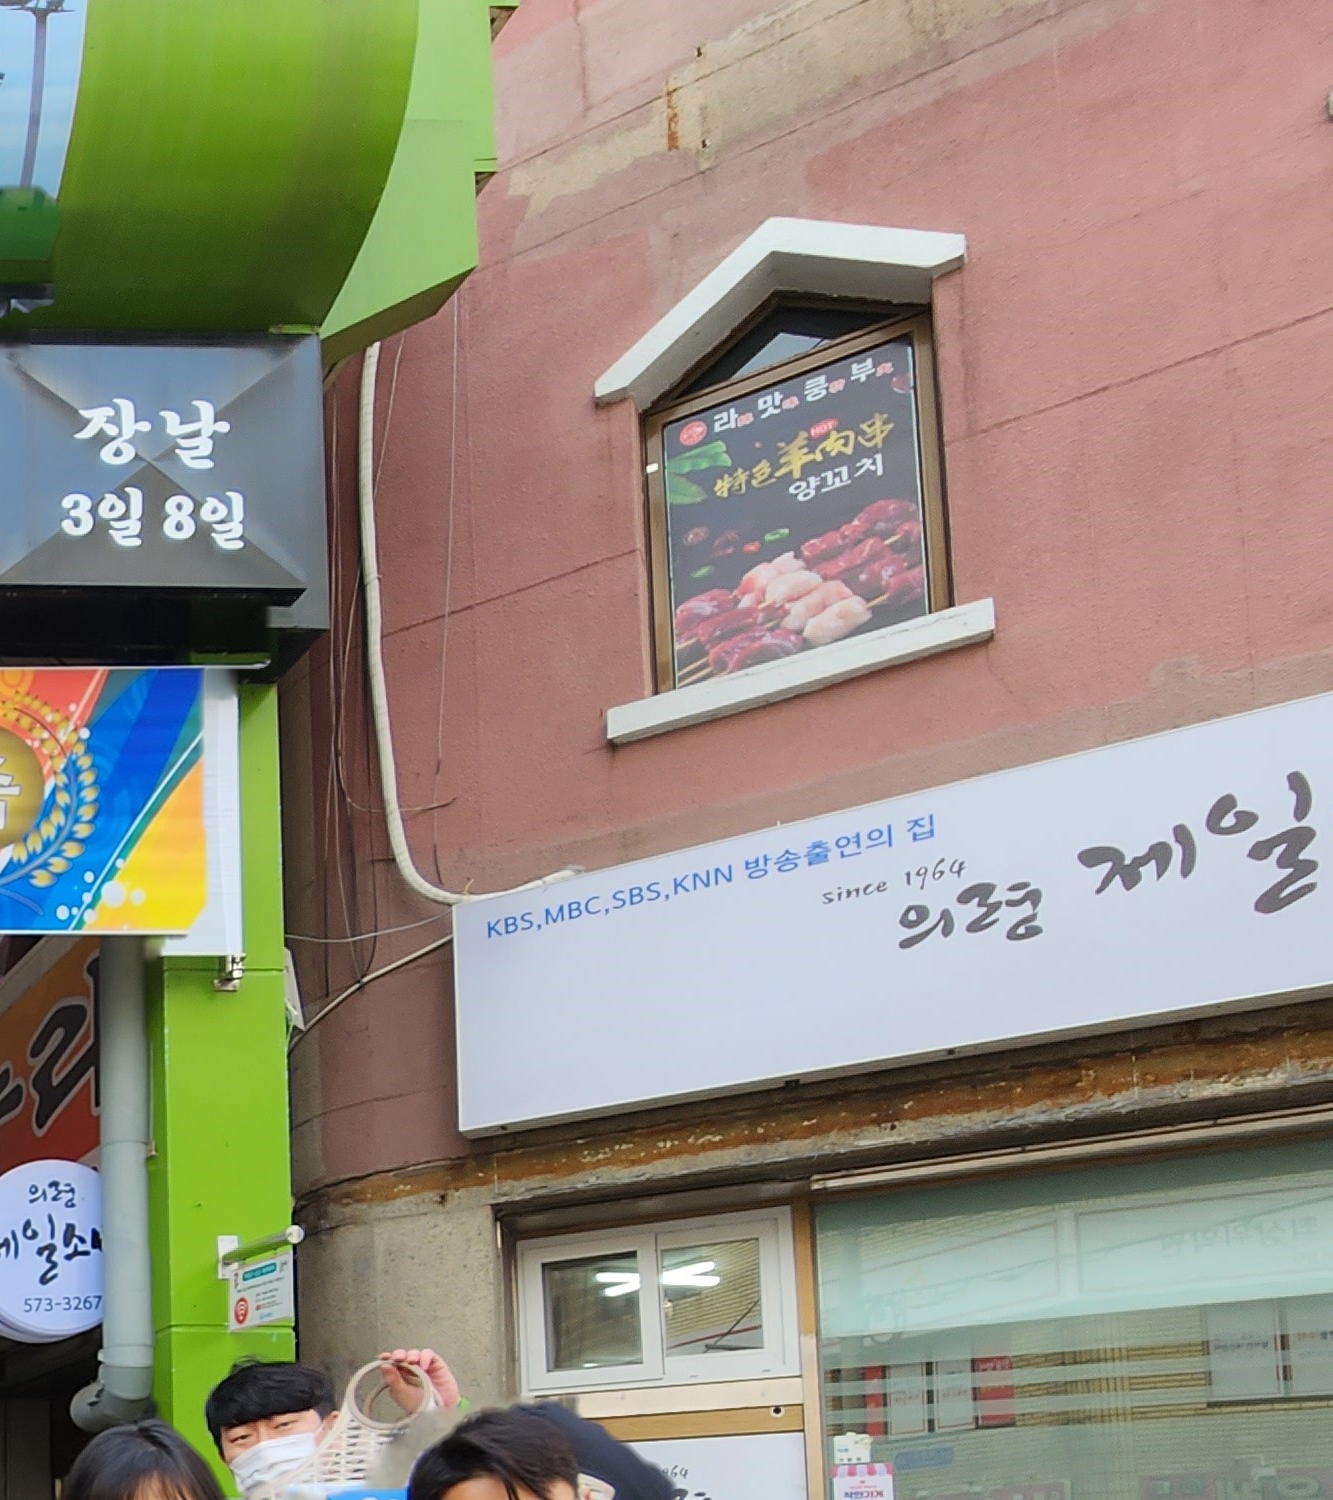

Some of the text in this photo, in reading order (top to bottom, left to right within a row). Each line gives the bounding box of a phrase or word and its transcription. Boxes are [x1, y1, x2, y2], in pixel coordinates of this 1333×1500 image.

[73, 397, 232, 471] 장날
[788, 453, 884, 501] 양꼬치
[60, 491, 247, 551] 3일 8일
[742, 820, 896, 883] 방송출연의
[907, 813, 937, 843] 집
[822, 857, 969, 906] since 1964
[897, 882, 1044, 951] 의령
